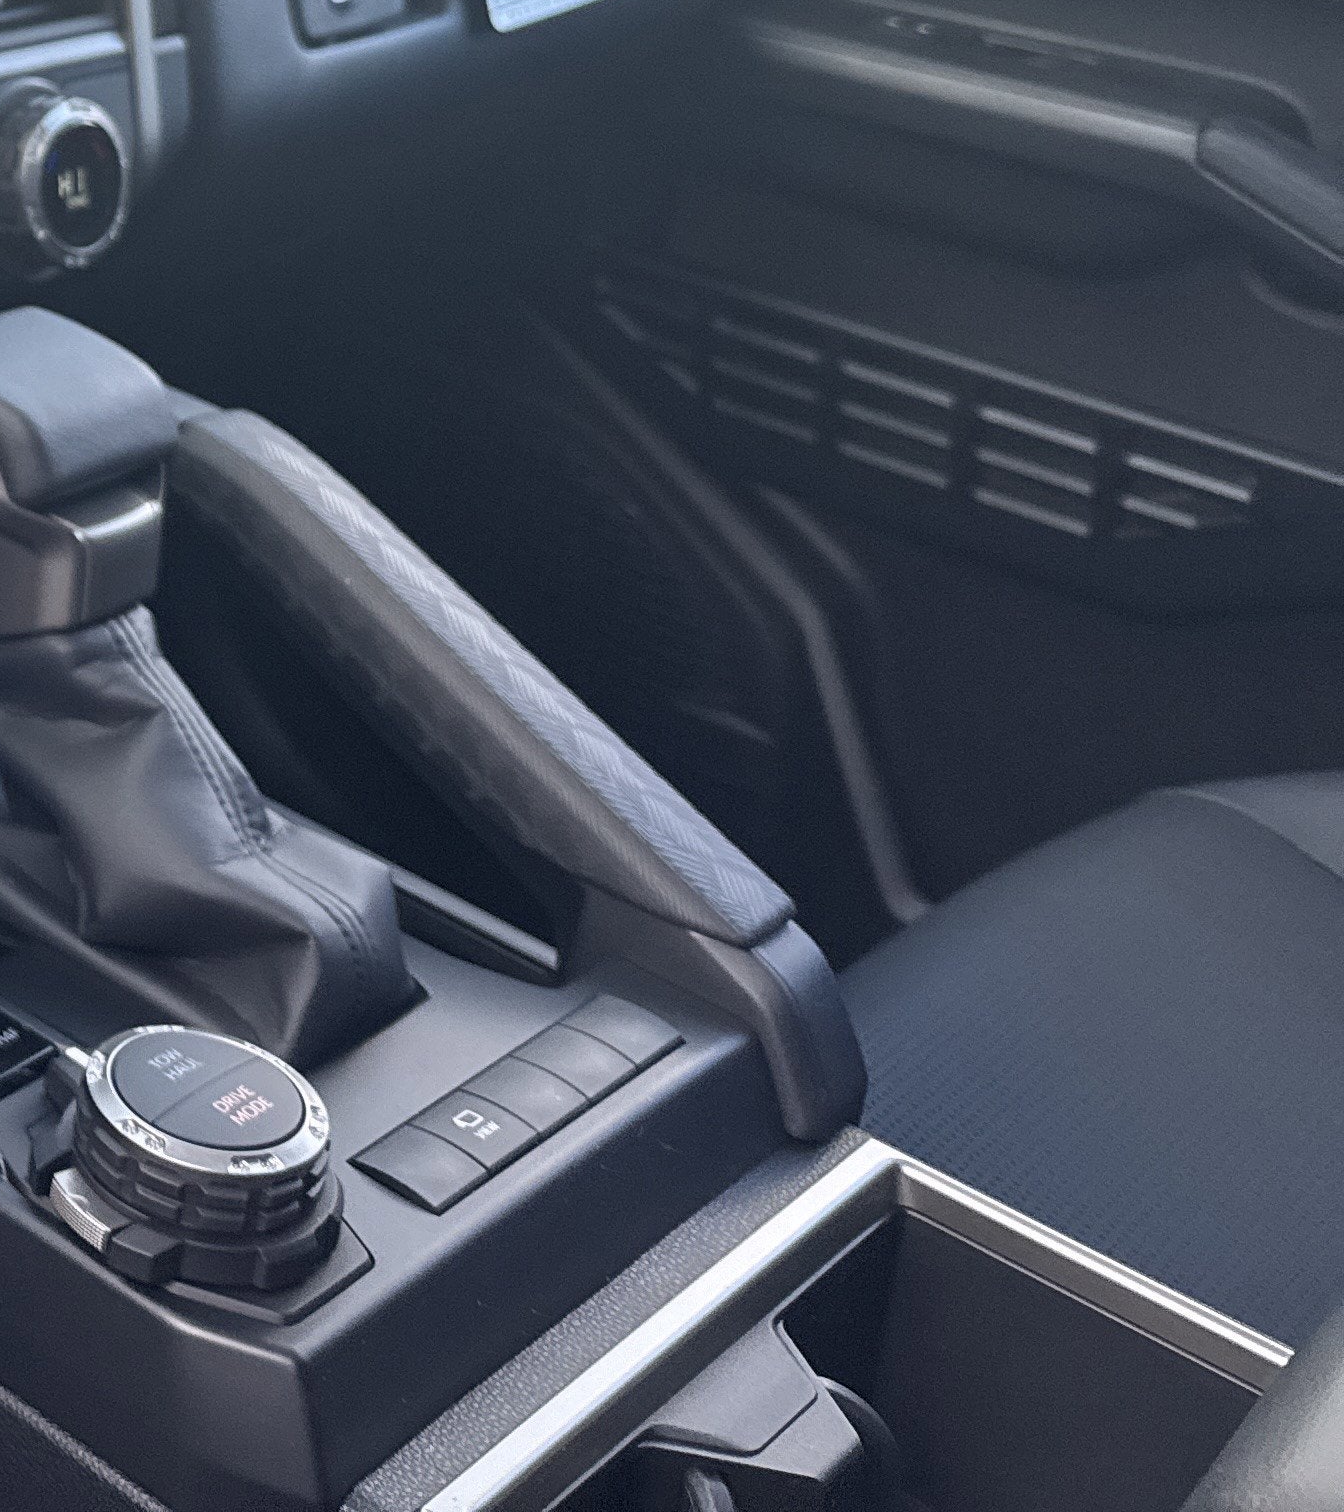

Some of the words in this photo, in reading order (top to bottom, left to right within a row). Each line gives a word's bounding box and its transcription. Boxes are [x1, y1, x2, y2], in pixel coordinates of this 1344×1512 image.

[146, 1047, 183, 1070] TOW
[162, 1056, 205, 1083] HAUL
[211, 1084, 258, 1114] DRIVE
[229, 1095, 276, 1127] MODE
